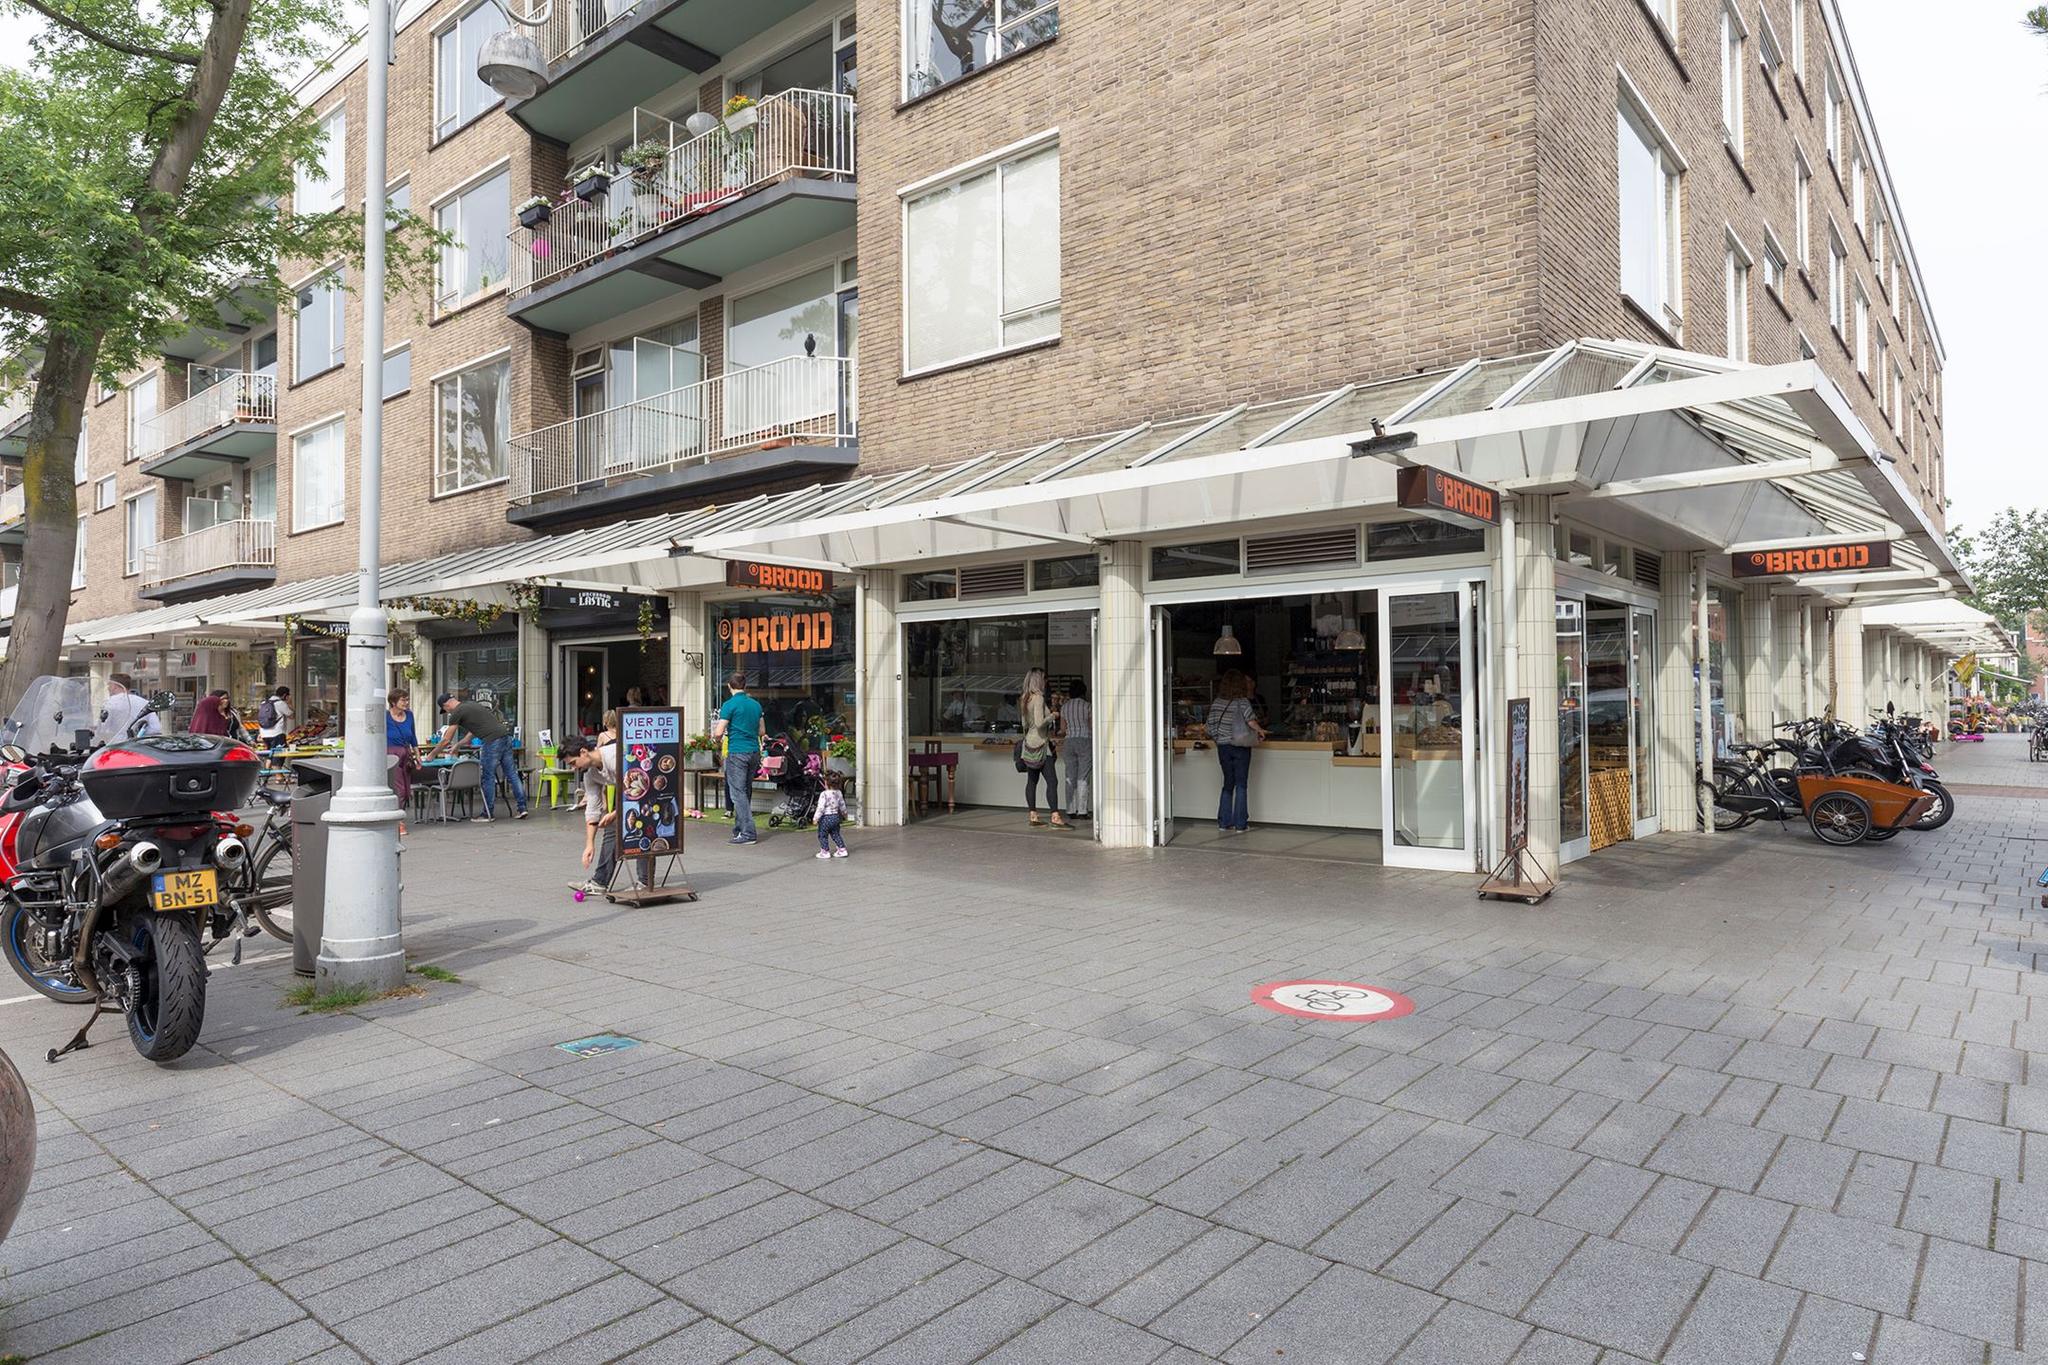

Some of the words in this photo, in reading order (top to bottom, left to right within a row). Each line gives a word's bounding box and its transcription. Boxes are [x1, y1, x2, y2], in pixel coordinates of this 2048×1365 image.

[1443, 476, 1492, 520] BROOD
[1766, 545, 1869, 573] BROOD
[759, 565, 823, 591] BROOD
[579, 596, 611, 609] LASTIG
[732, 611, 833, 654] BROOD
[185, 638, 238, 648] Holthuizen
[181, 652, 197, 667] AKO
[625, 717, 653, 727] VIER
[658, 717, 673, 726] DE
[175, 873, 203, 889] MZ
[161, 889, 213, 907] BN-51
